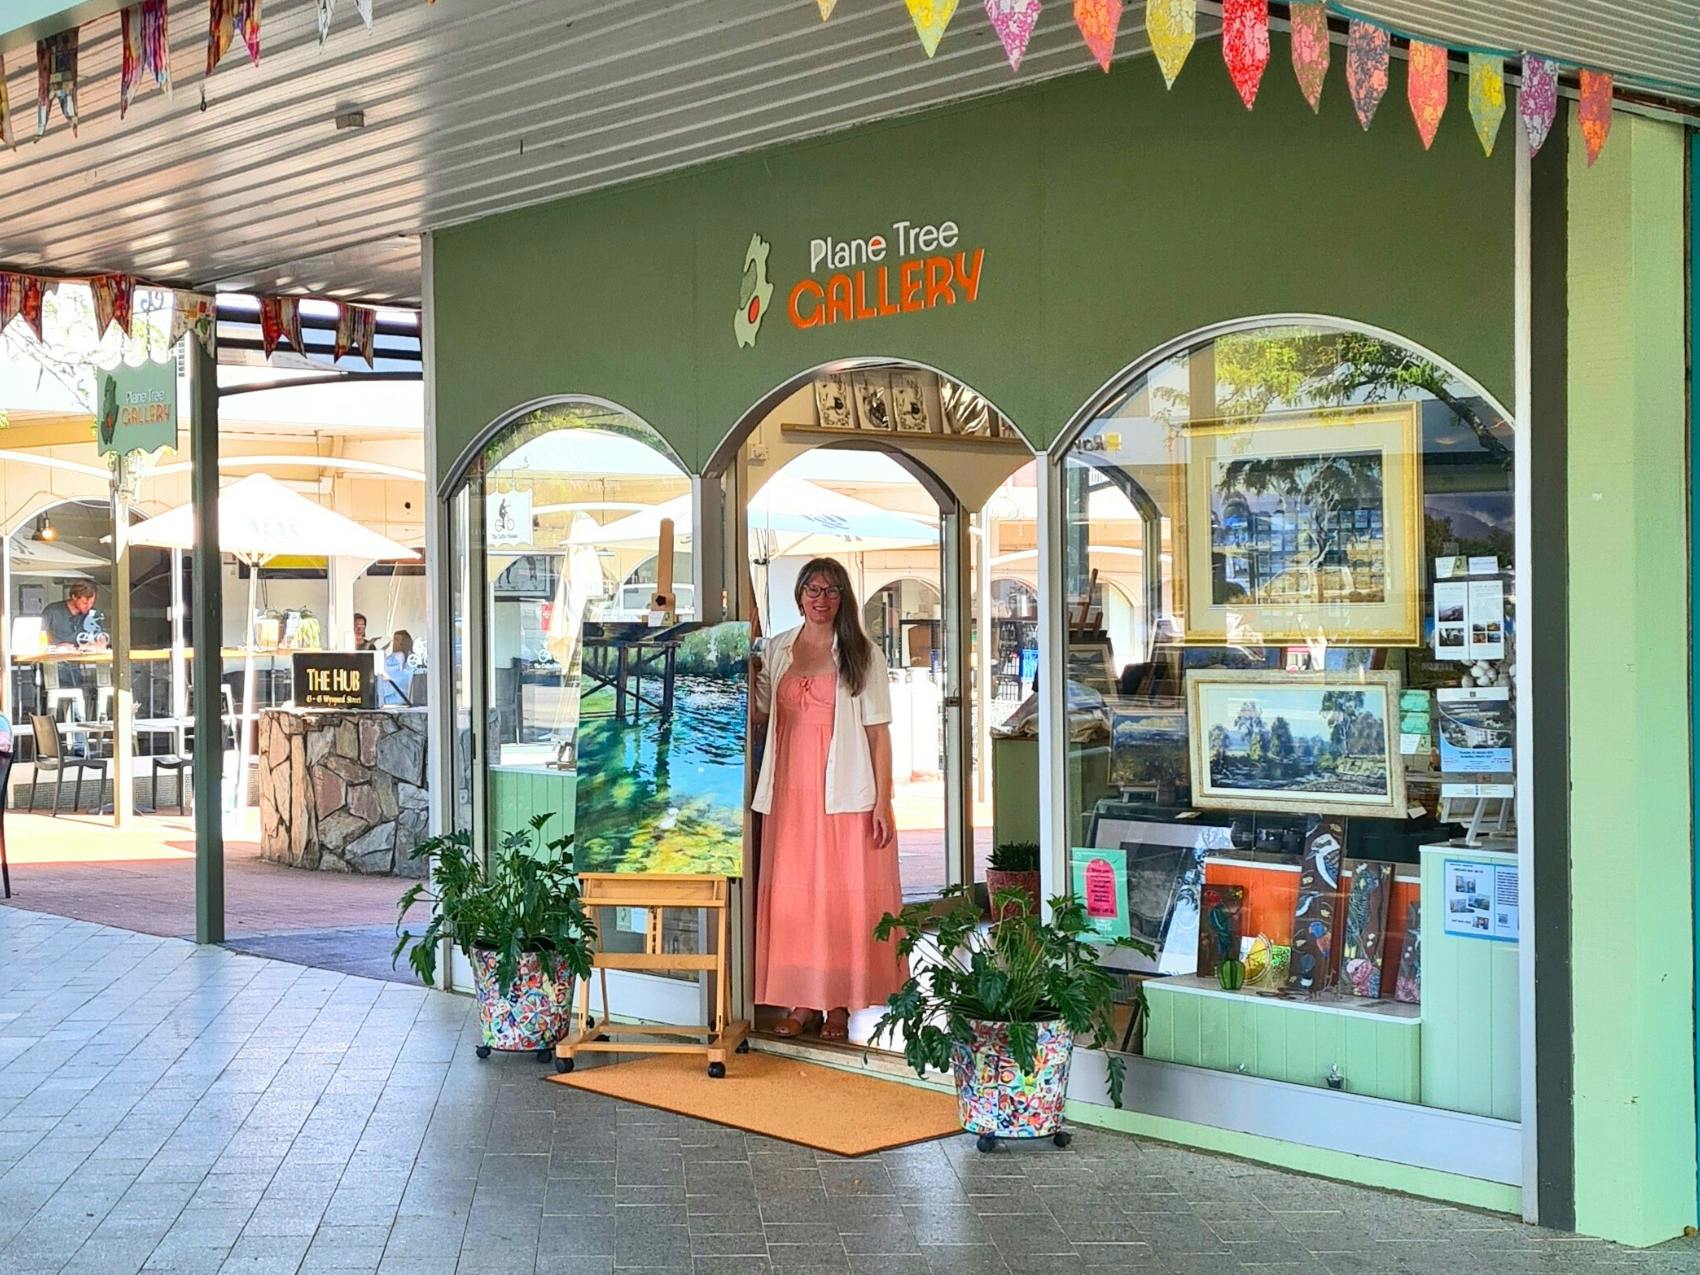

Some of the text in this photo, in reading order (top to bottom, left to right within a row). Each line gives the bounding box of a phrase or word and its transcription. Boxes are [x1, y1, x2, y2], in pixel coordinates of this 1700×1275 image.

[810, 220, 959, 273] Plane Tree
[787, 248, 985, 330] GALLERY
[125, 389, 166, 404] Plane Tree
[121, 403, 171, 427] GALLERY
[306, 668, 361, 692] THE HUB
